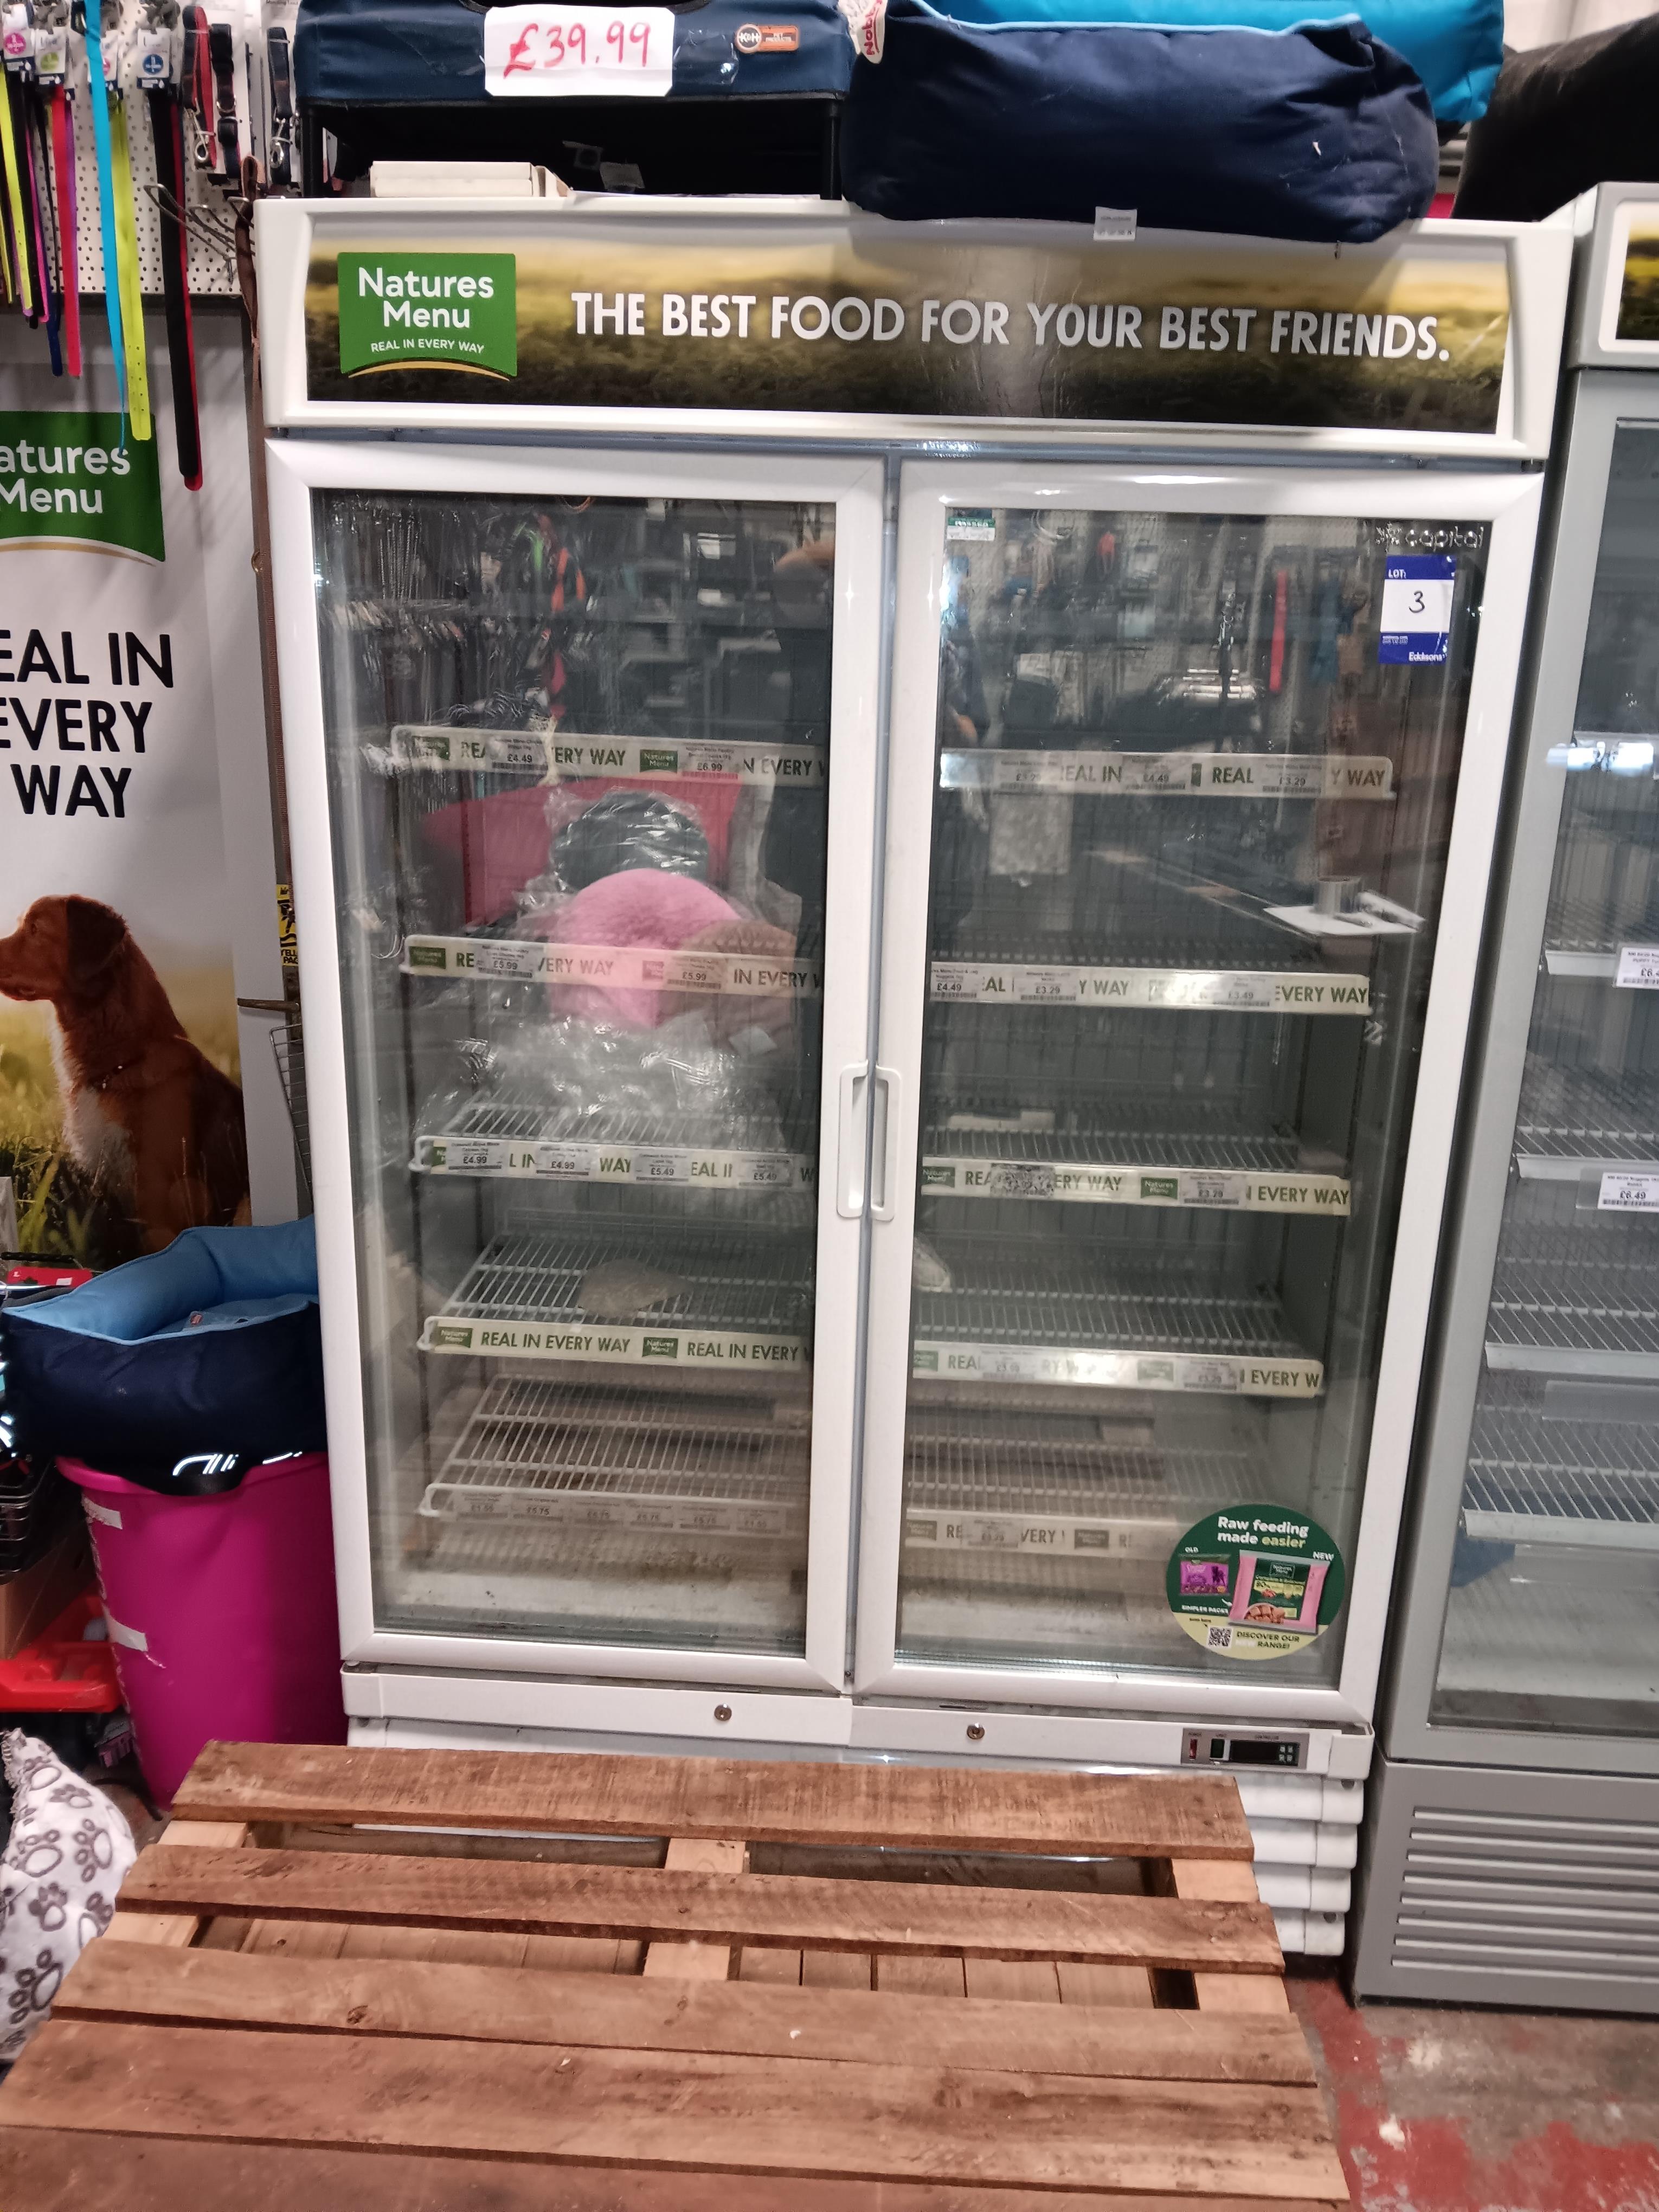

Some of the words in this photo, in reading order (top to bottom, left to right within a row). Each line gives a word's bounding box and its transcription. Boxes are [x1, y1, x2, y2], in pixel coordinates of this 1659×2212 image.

[503, 22, 651, 79] £39.99
[358, 266, 494, 298] Natures
[383, 300, 471, 328] Menu
[571, 292, 645, 336] THE
[662, 293, 756, 339] BEST
[771, 296, 905, 342] FOOD
[922, 299, 1009, 346] FOR
[1026, 302, 1143, 349] YOUR
[1160, 306, 1258, 352] BEST
[1270, 310, 1450, 361] FRIENDS.
[371, 340, 400, 353] REAL
[403, 338, 415, 348] IN
[418, 338, 455, 350] EVERY
[458, 340, 485, 353] WAY
[0, 440, 131, 475] atures
[0, 478, 104, 513] Menu
[1409, 590, 1425, 613] 3
[0, 629, 89, 684] EAL
[108, 631, 174, 688] IN
[590, 748, 626, 767] WAY
[1212, 766, 1255, 785] REAL
[10, 763, 132, 818] WAY
[456, 952, 474, 968] RE
[733, 968, 752, 986] IN
[758, 969, 809, 988] EVERY
[1093, 980, 1130, 996] WAY
[1330, 986, 1368, 1004] WAY
[691, 1161, 718, 1178] EAL
[1258, 1185, 1308, 1203] EVERY
[1314, 1188, 1349, 1205] WAY
[480, 1332, 518, 1348] REAL
[523, 1334, 541, 1349] IN
[545, 1334, 593, 1351] EVERY
[598, 1337, 631, 1353] WAY
[687, 1341, 724, 1358] REAL
[729, 1343, 747, 1359] IN
[751, 1345, 799, 1362] EVERY
[1251, 1368, 1300, 1387] EVERY
[1218, 1516, 1249, 1531] Raw
[1252, 1519, 1309, 1539] feeding
[1217, 1531, 1258, 1545] made
[1261, 1535, 1306, 1549] easier
[1312, 1551, 1335, 1561] NEW
[1236, 1631, 1279, 1641] DISCOVER
[1281, 1633, 1300, 1643] OUR
